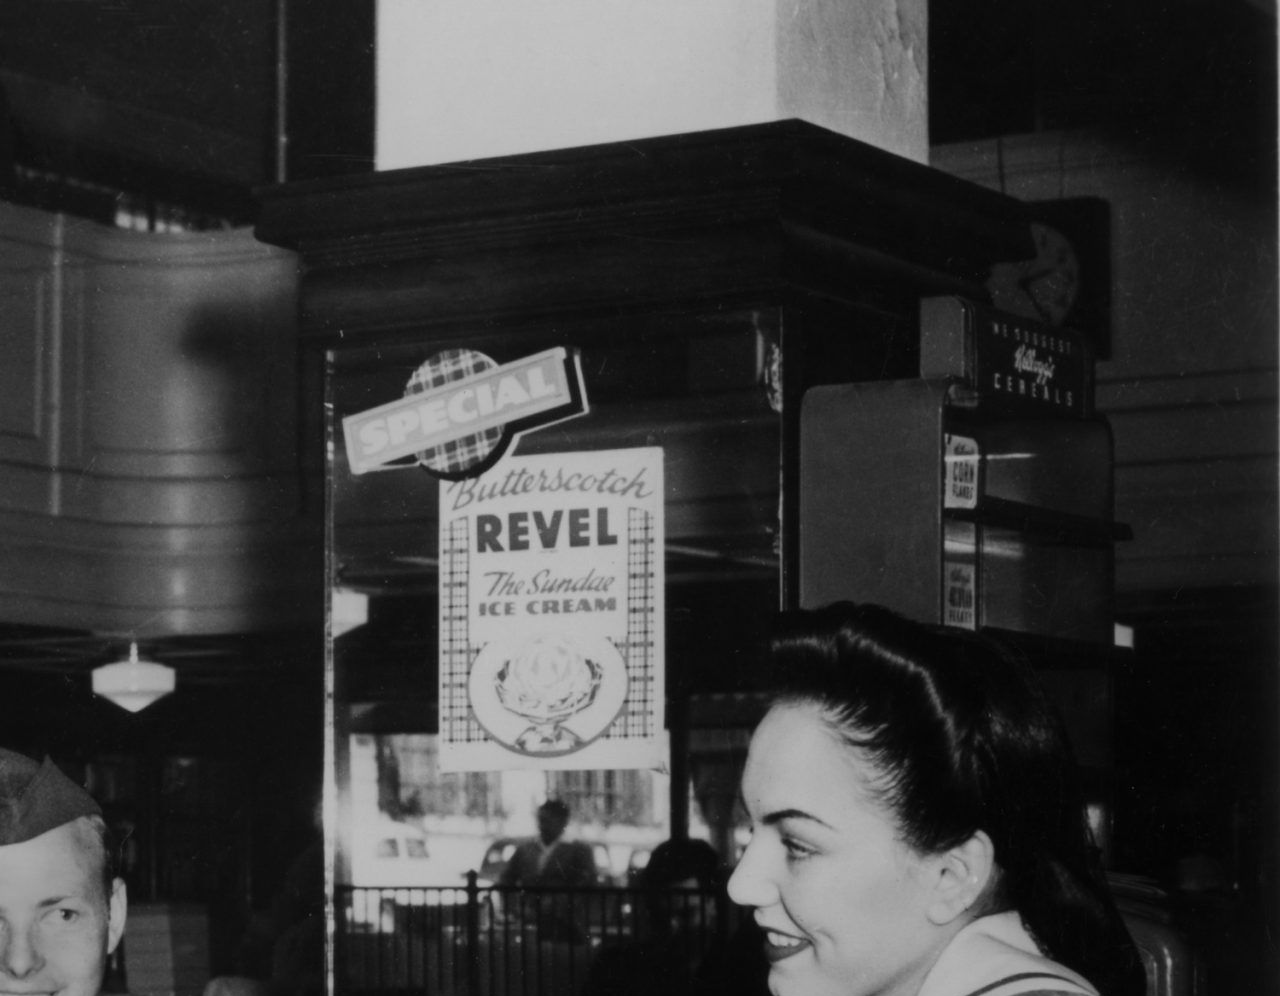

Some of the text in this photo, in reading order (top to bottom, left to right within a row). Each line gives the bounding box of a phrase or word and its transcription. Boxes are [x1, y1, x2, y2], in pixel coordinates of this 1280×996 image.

[992, 371, 1073, 407] CEREALS
[357, 365, 557, 457] SPECIAL
[445, 467, 654, 511] Butterscotch
[476, 507, 619, 553] REVEL
[483, 568, 617, 597] The Sundae
[478, 598, 618, 617] ICE CREAM
